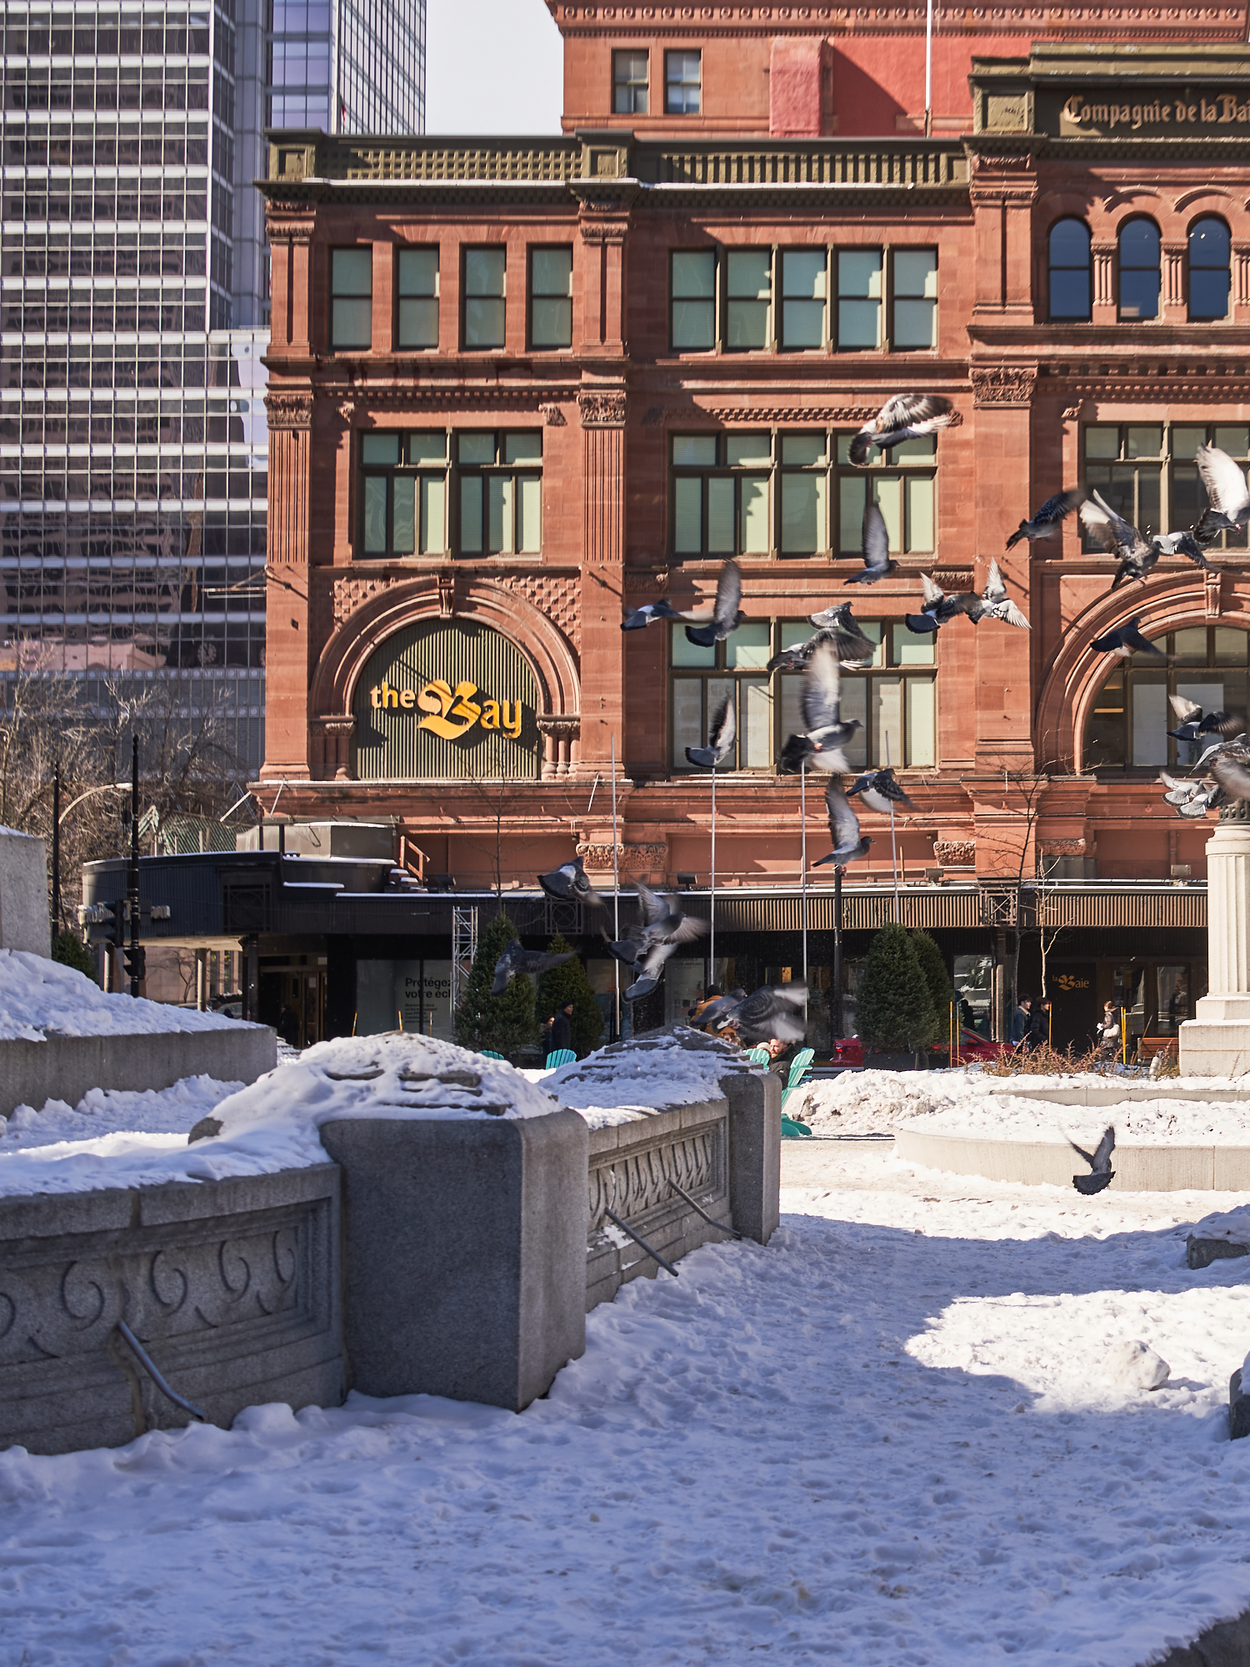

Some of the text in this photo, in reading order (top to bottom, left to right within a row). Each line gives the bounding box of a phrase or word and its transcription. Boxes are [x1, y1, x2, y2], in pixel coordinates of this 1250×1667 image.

[1062, 95, 1172, 129] Compagnie
[1174, 99, 1198, 123] de
[1200, 97, 1218, 122] la
[370, 679, 523, 740] the Bay
[1058, 974, 1090, 991] Baie
